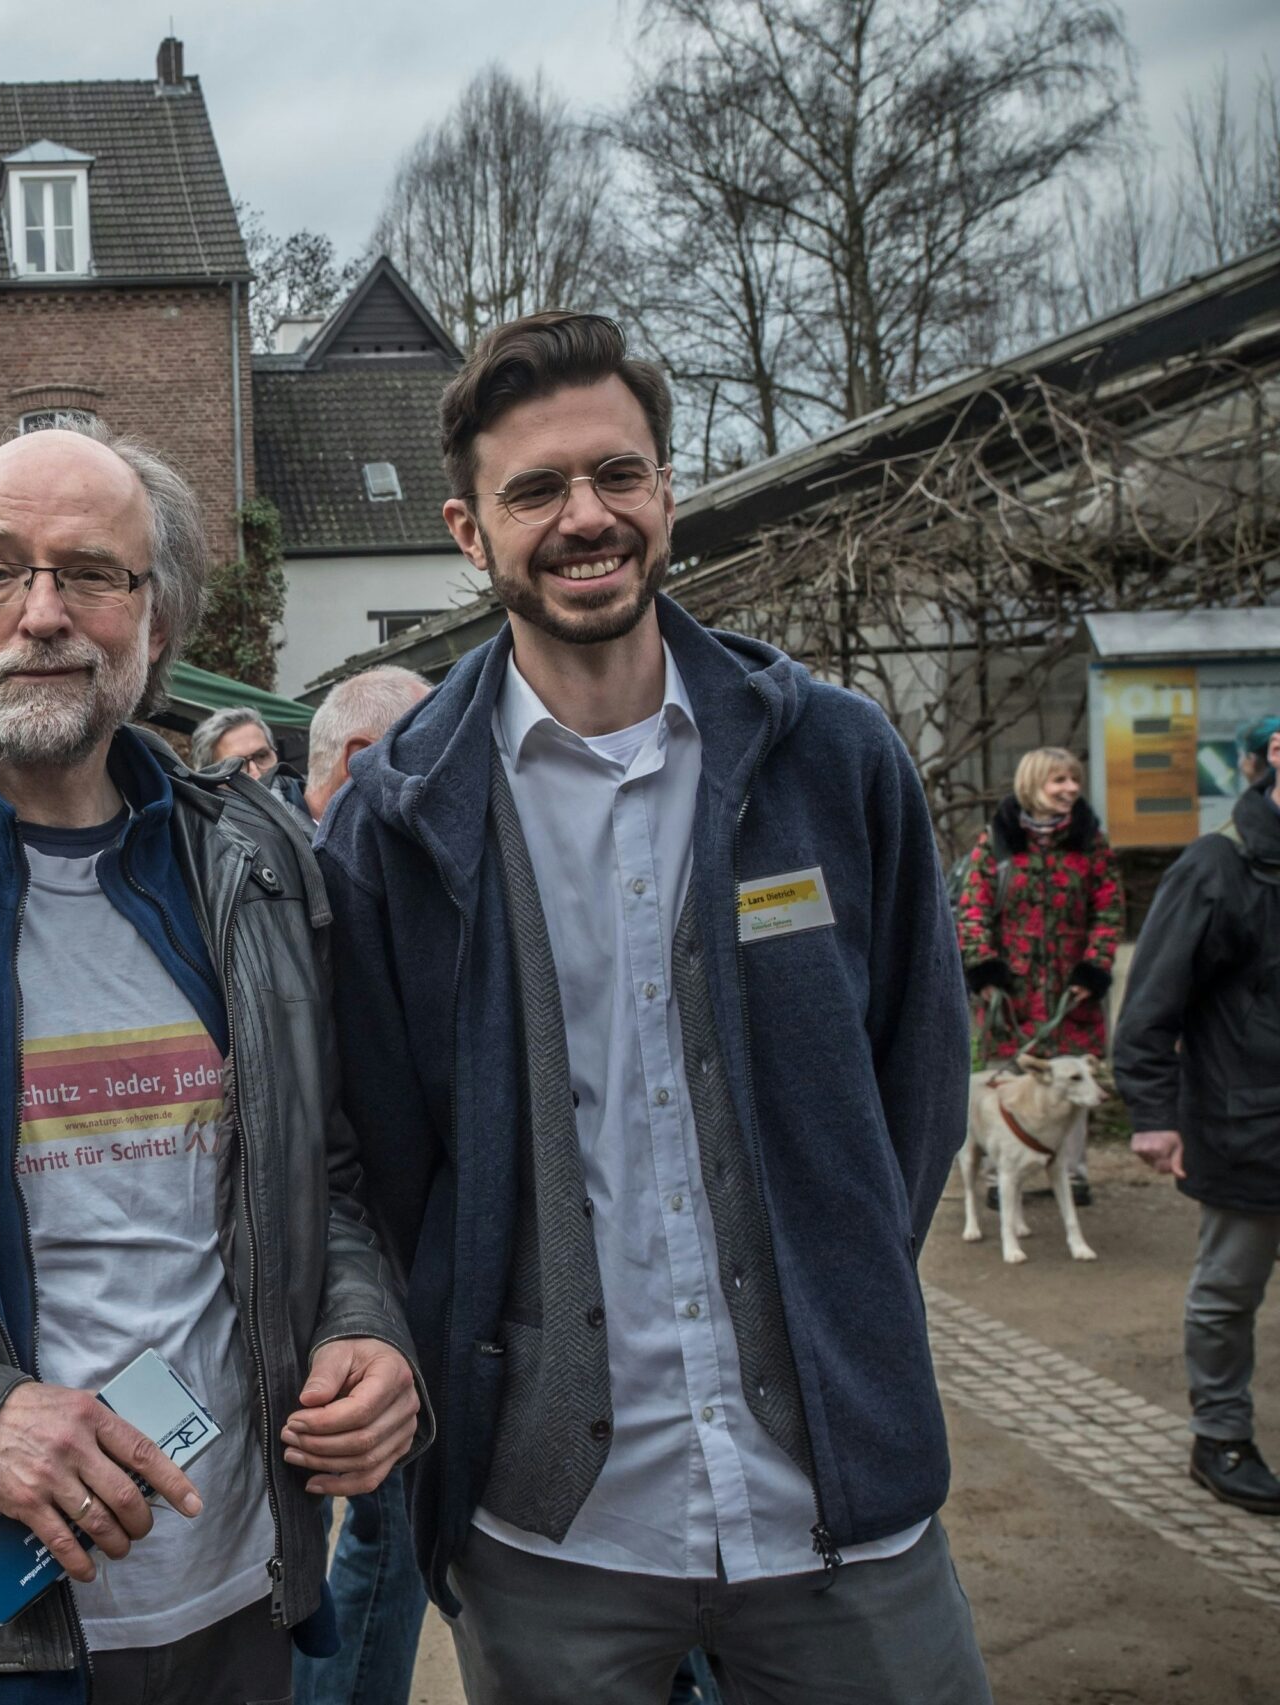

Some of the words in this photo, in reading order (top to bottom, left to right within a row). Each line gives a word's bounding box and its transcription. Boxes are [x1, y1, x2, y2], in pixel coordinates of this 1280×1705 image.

[748, 896, 765, 905] Lars
[766, 888, 795, 901] Dietrich
[21, 1083, 81, 1106] chutz
[105, 1073, 166, 1097] Jeder,
[17, 1151, 70, 1175] chritt
[74, 1146, 104, 1166] für
[111, 1136, 177, 1161] Schritt!
